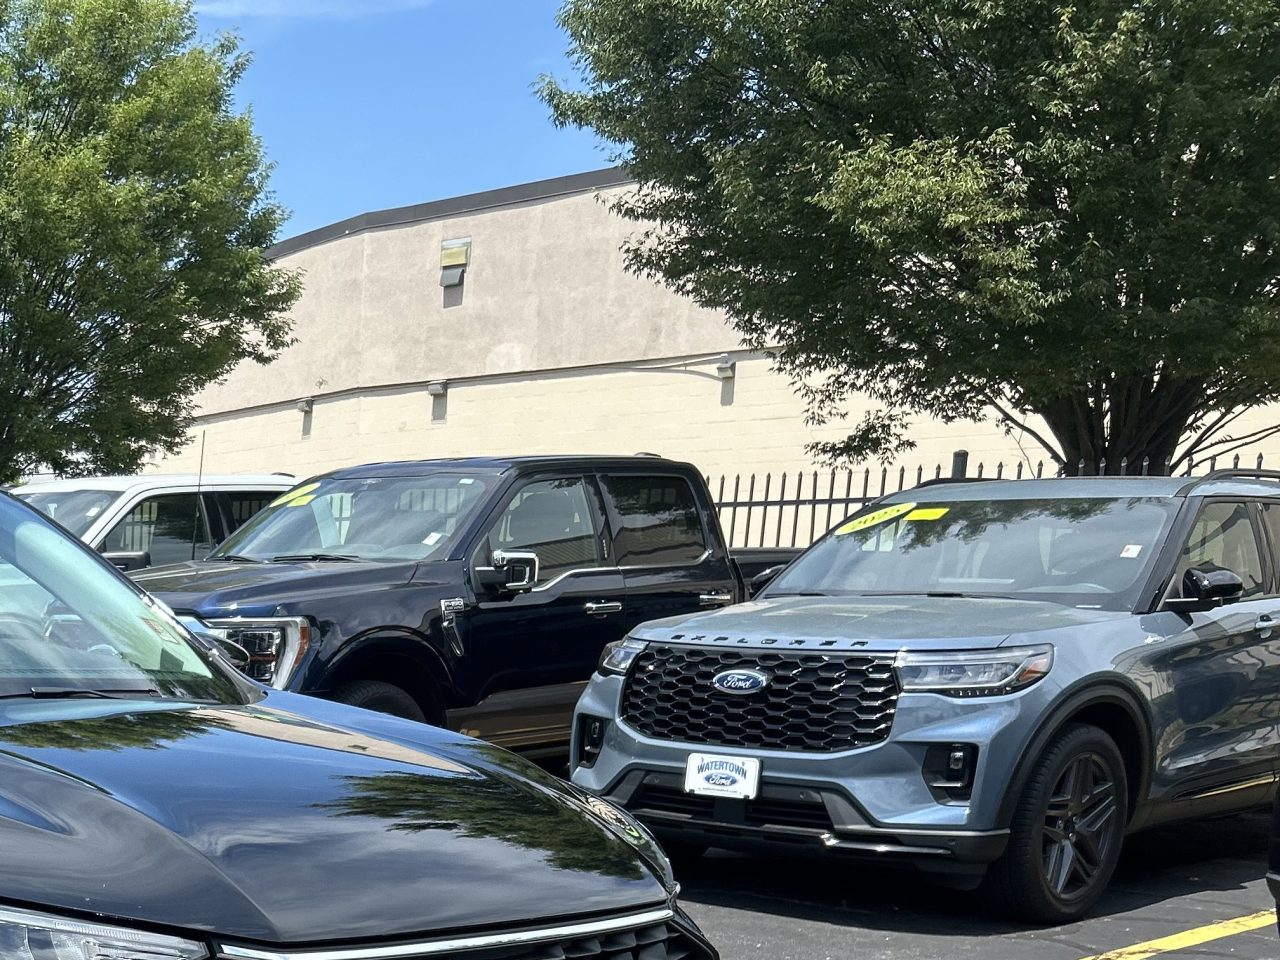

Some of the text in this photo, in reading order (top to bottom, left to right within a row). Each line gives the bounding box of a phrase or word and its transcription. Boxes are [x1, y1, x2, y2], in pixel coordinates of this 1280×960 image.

[671, 634, 869, 647] EXPLORER
[723, 675, 753, 689] Ford
[697, 760, 748, 779] WATERTOWN
[709, 774, 733, 786] Ford
